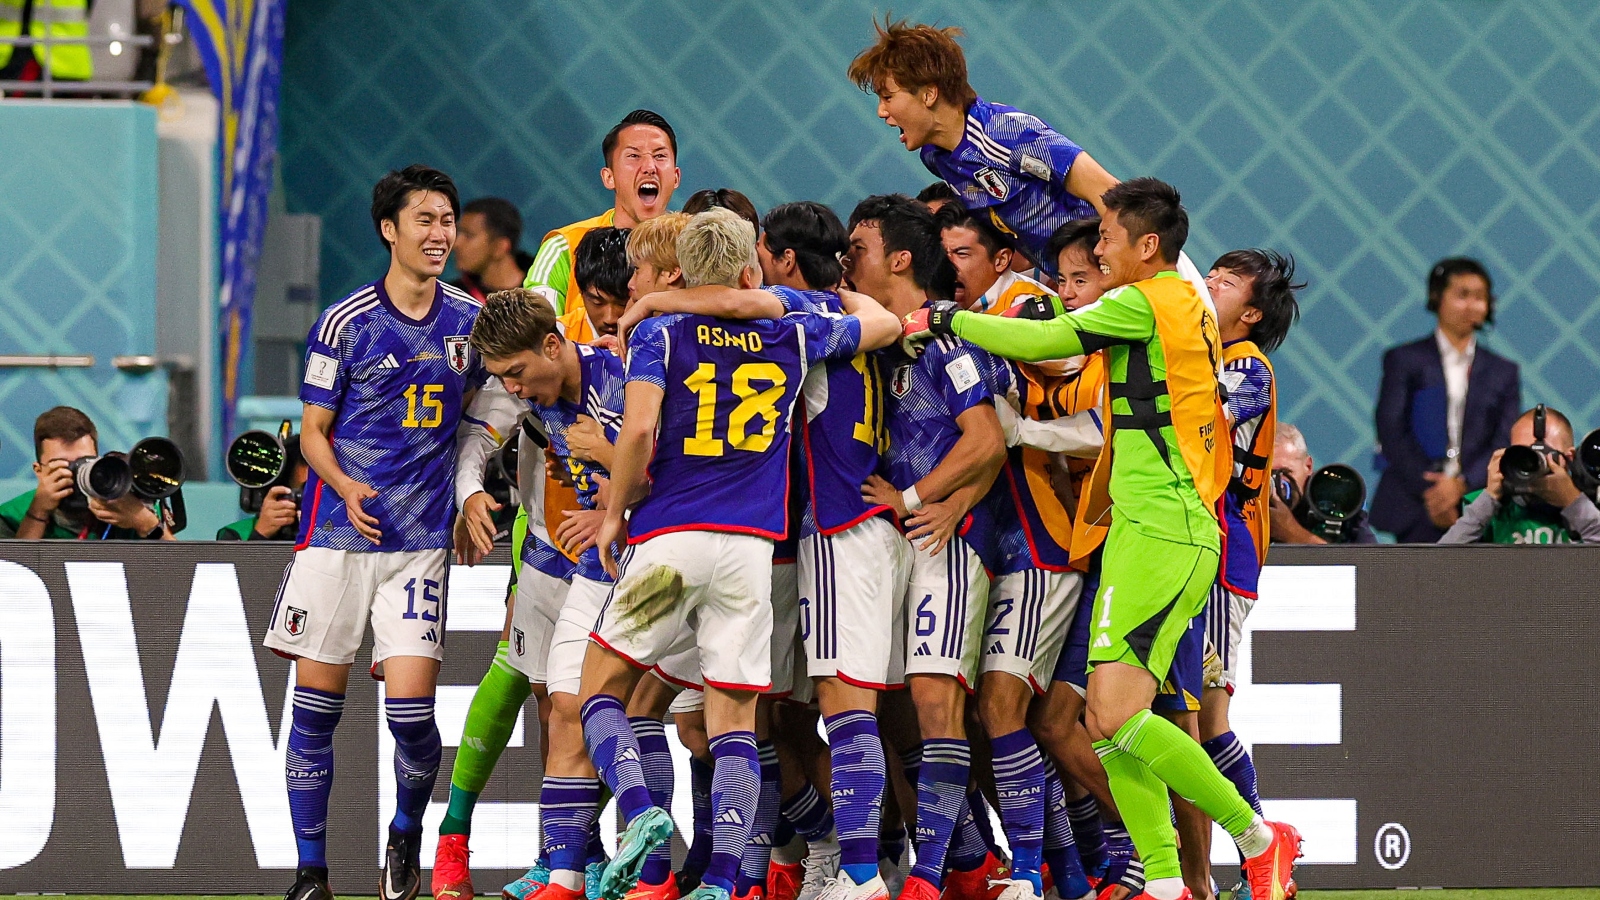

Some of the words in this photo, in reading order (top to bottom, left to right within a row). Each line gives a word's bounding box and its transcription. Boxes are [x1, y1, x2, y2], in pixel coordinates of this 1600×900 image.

[697, 324, 763, 353] ASANO
[402, 383, 444, 428] 15
[683, 362, 788, 457] 18
[402, 577, 440, 623] 15
[915, 594, 936, 637] 6
[986, 598, 1014, 635] 2
[1098, 586, 1114, 628] 1
[998, 786, 1041, 797] APAN
